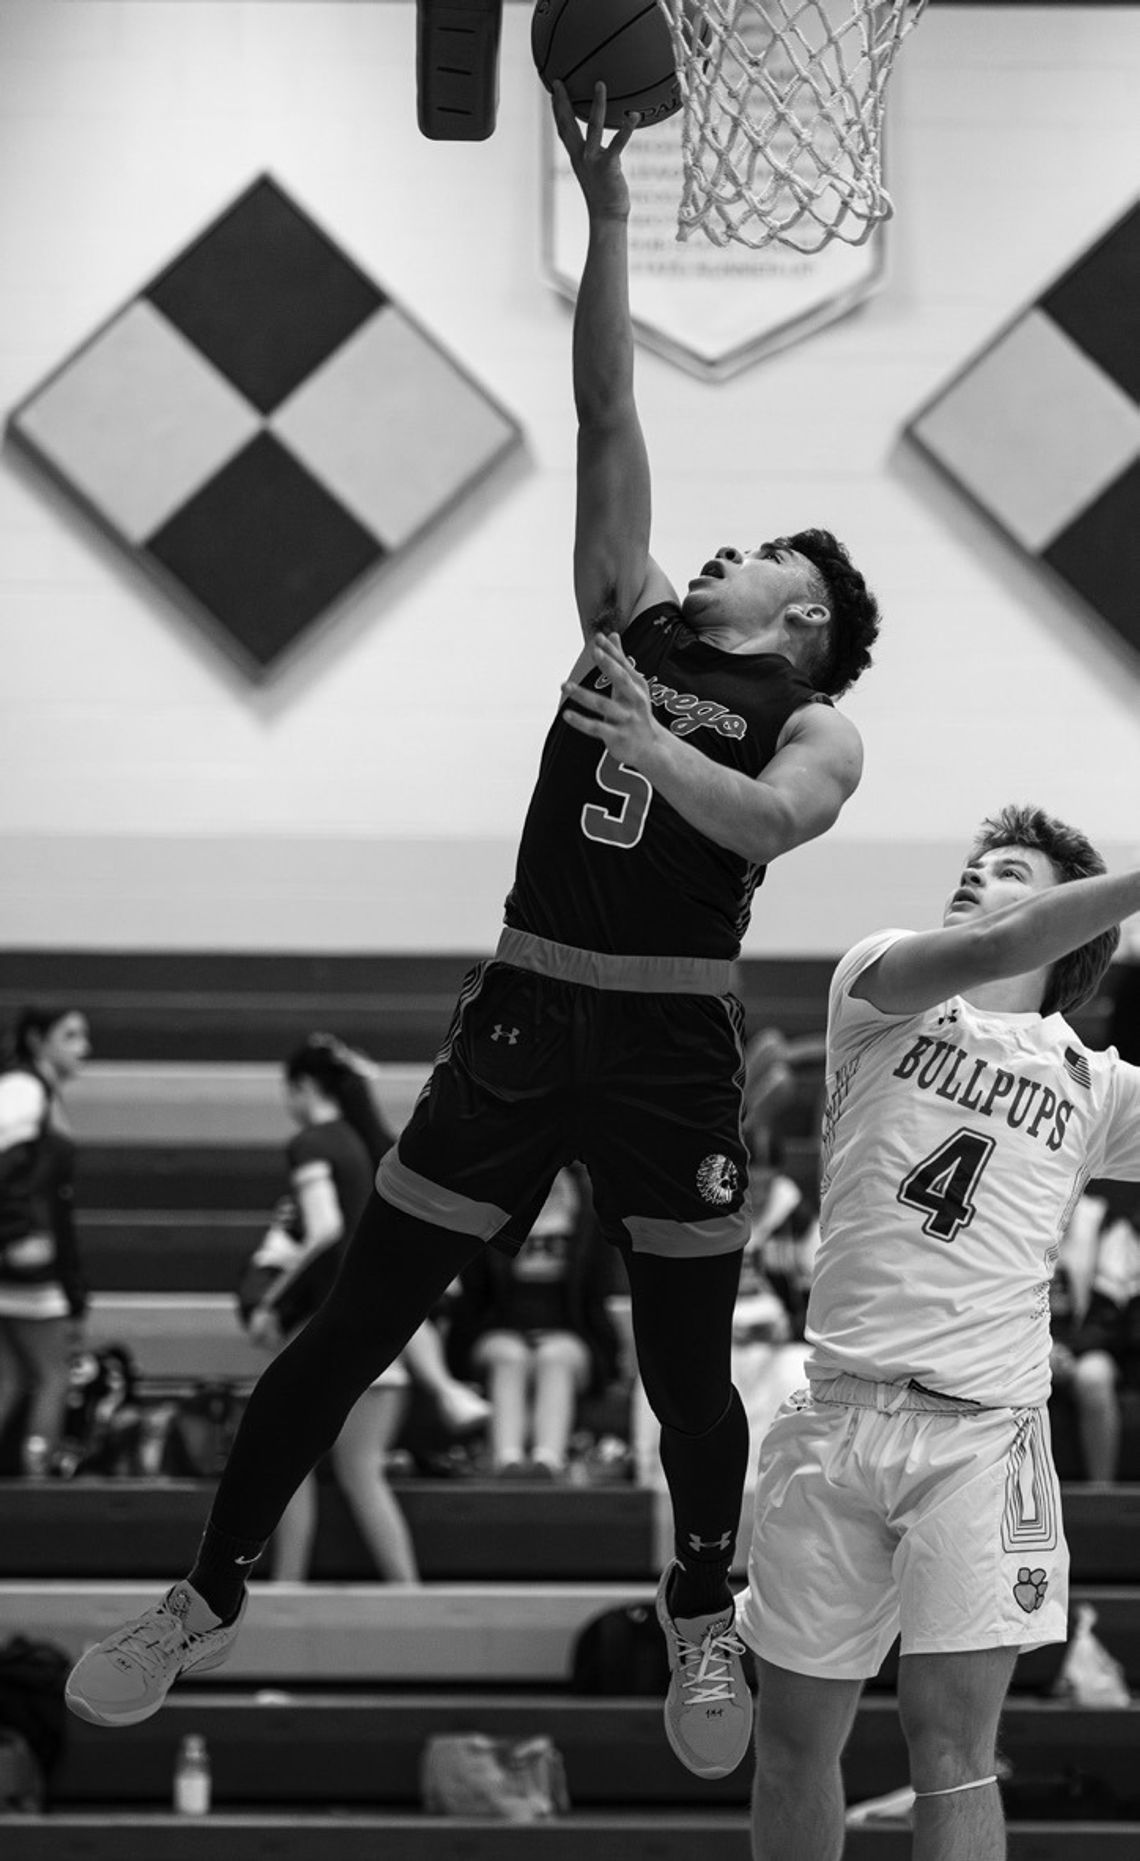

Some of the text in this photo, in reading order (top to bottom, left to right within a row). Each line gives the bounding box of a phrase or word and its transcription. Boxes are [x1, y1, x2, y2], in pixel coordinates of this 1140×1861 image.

[580, 748, 653, 849] 5
[892, 1035, 1075, 1151] BULLPUPS
[896, 1126, 997, 1243] 4
